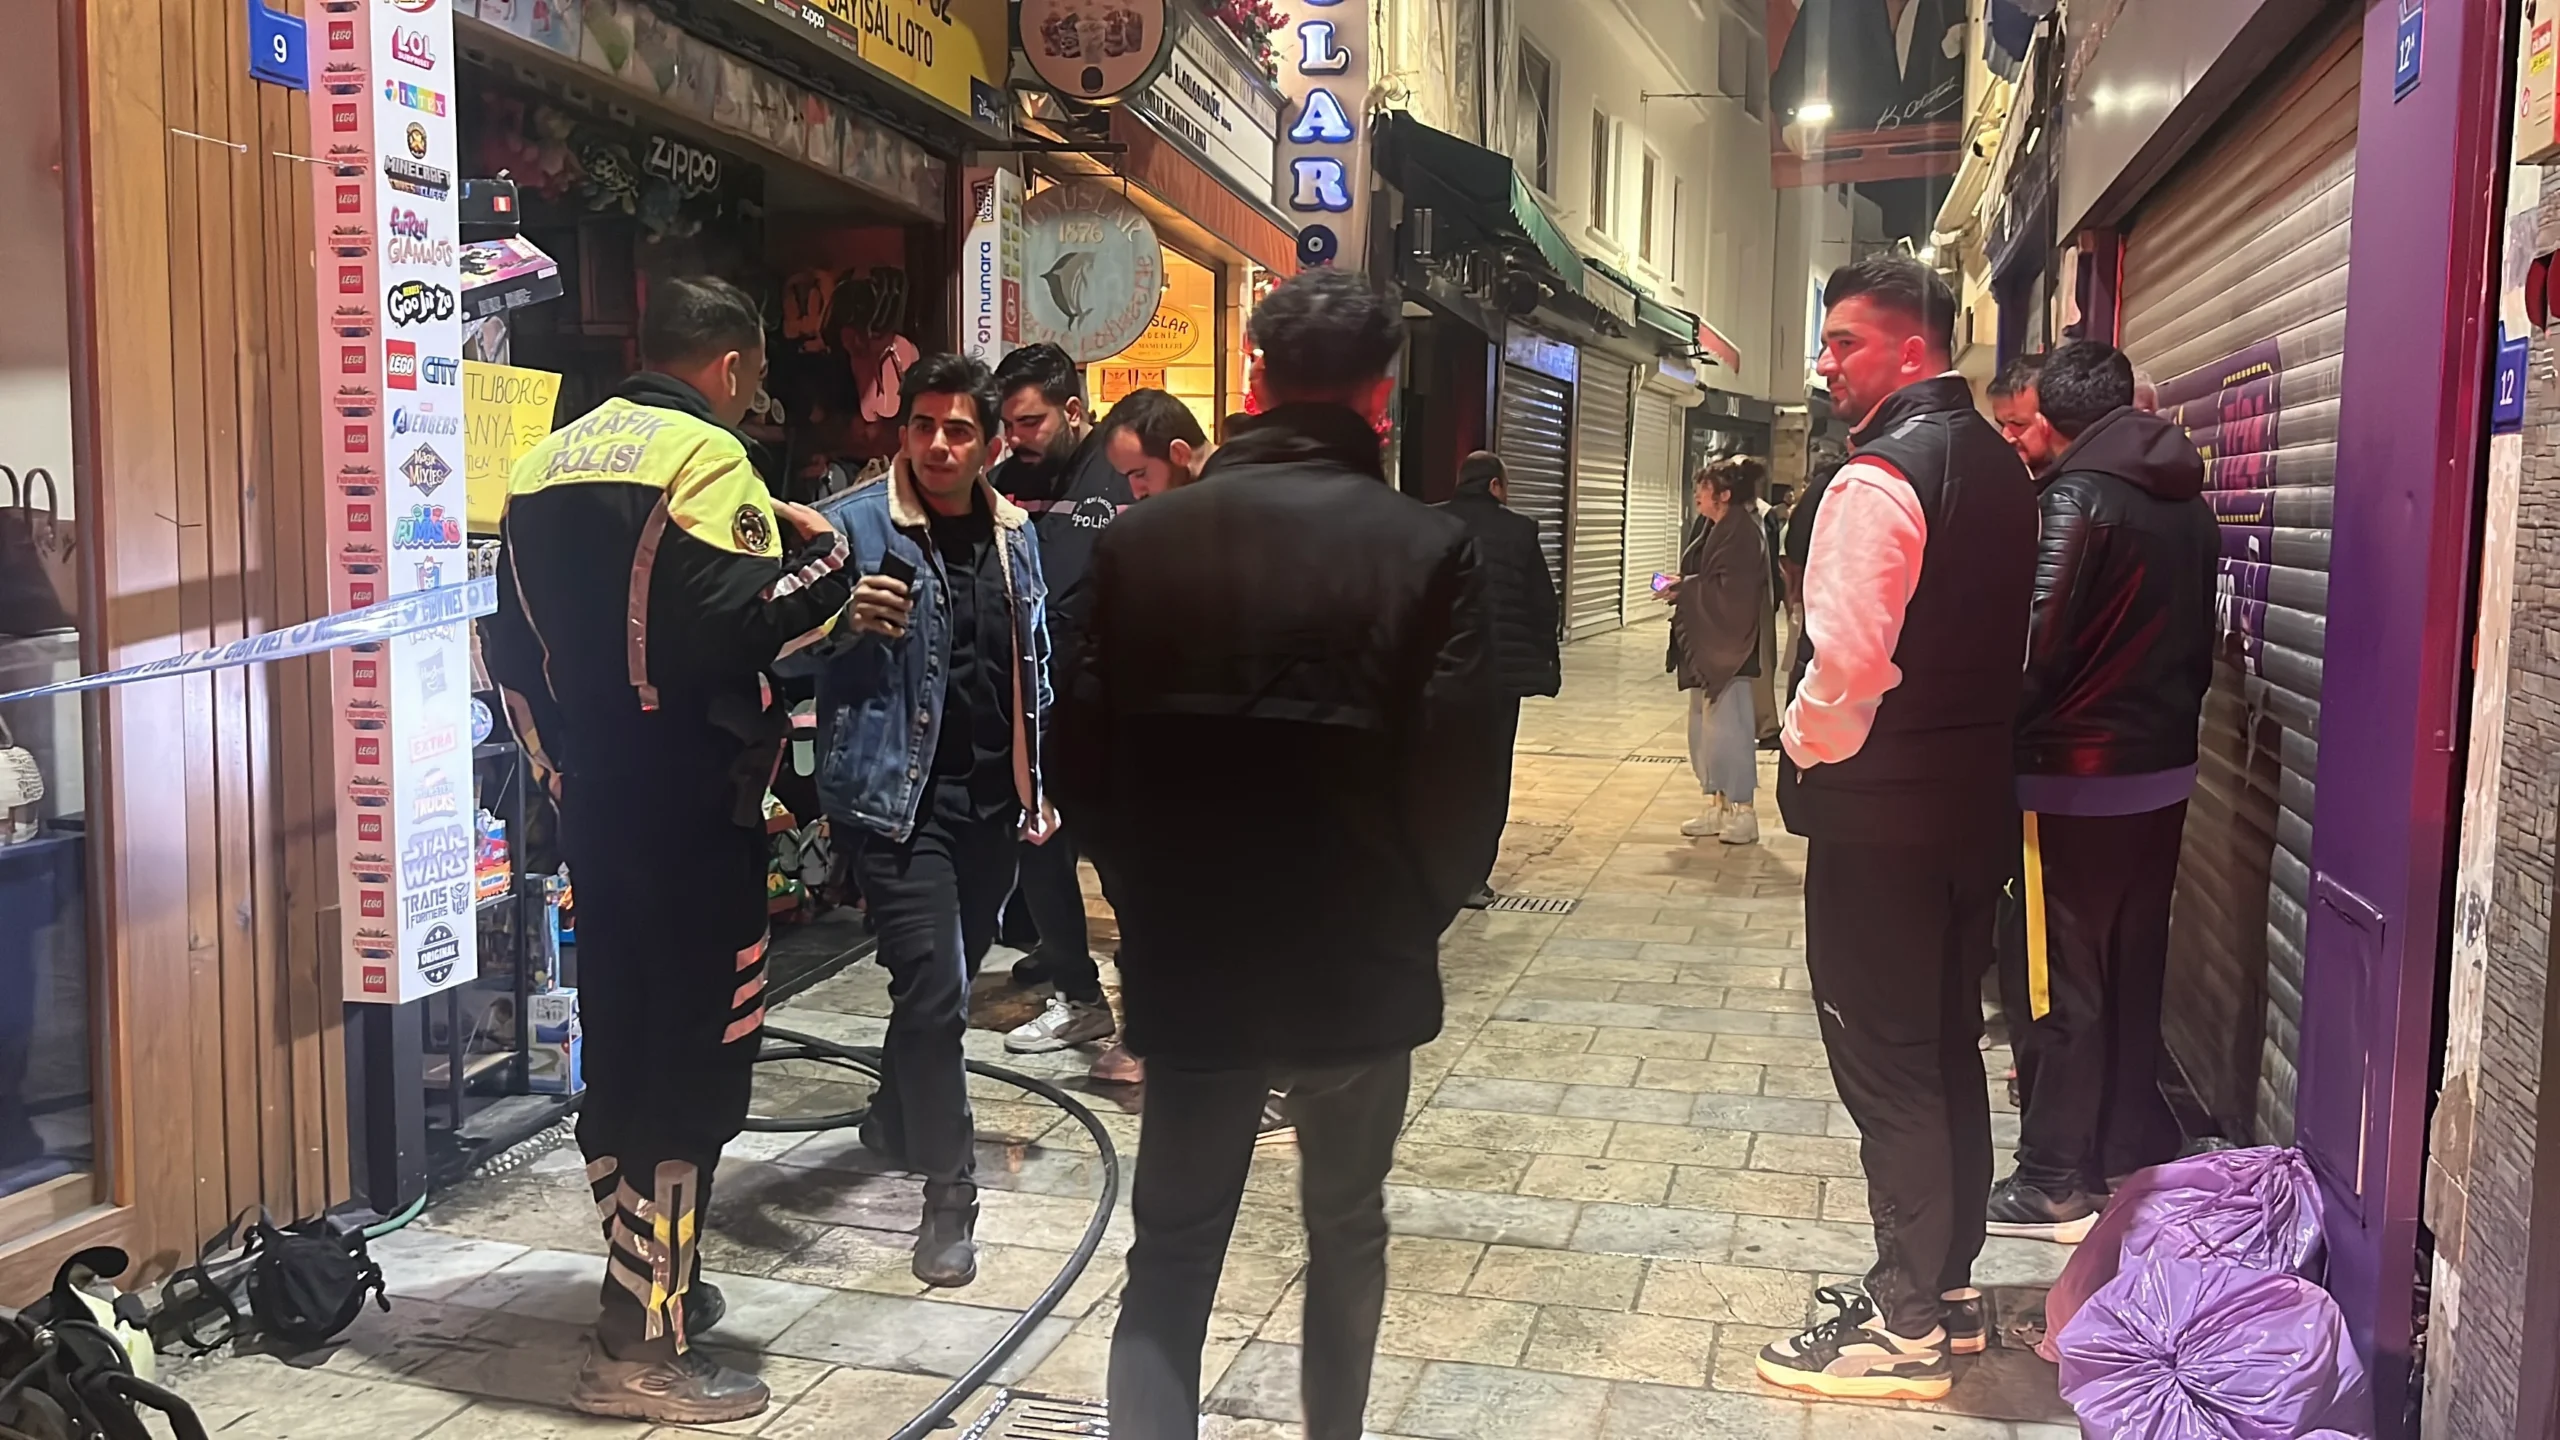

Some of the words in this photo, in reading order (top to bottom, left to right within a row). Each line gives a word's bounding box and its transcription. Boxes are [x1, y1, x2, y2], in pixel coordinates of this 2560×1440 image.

[332, 30, 351, 40] LEGO
[396, 25, 436, 61] LOL
[897, 12, 933, 68] LOTO
[273, 34, 287, 63] 9
[400, 89, 444, 115] INTEX
[335, 113, 355, 122] LEGO
[384, 155, 451, 190] MINECRAFT
[339, 194, 358, 204] LEGO
[1058, 221, 1104, 244] 1876
[342, 275, 361, 285] LEGO
[980, 241, 991, 313] numara
[344, 355, 363, 365] LEGO
[389, 353, 415, 376] LEGO
[465, 373, 548, 406] TUBORG
[2500, 368, 2514, 406] 12
[391, 406, 458, 438] AVENGERS
[347, 434, 366, 443] LEGO
[350, 512, 369, 522] LEGO
[353, 591, 372, 601] LEGO
[355, 669, 374, 679] LEGO
[358, 746, 377, 755] LEGO
[414, 732, 453, 755] EXTRA
[360, 822, 379, 832] LEGO
[403, 825, 468, 861] STAR
[403, 853, 467, 889] WARS
[363, 899, 382, 909] LEGO
[421, 944, 456, 966] ORIGINAL
[365, 974, 384, 984] LEGO
